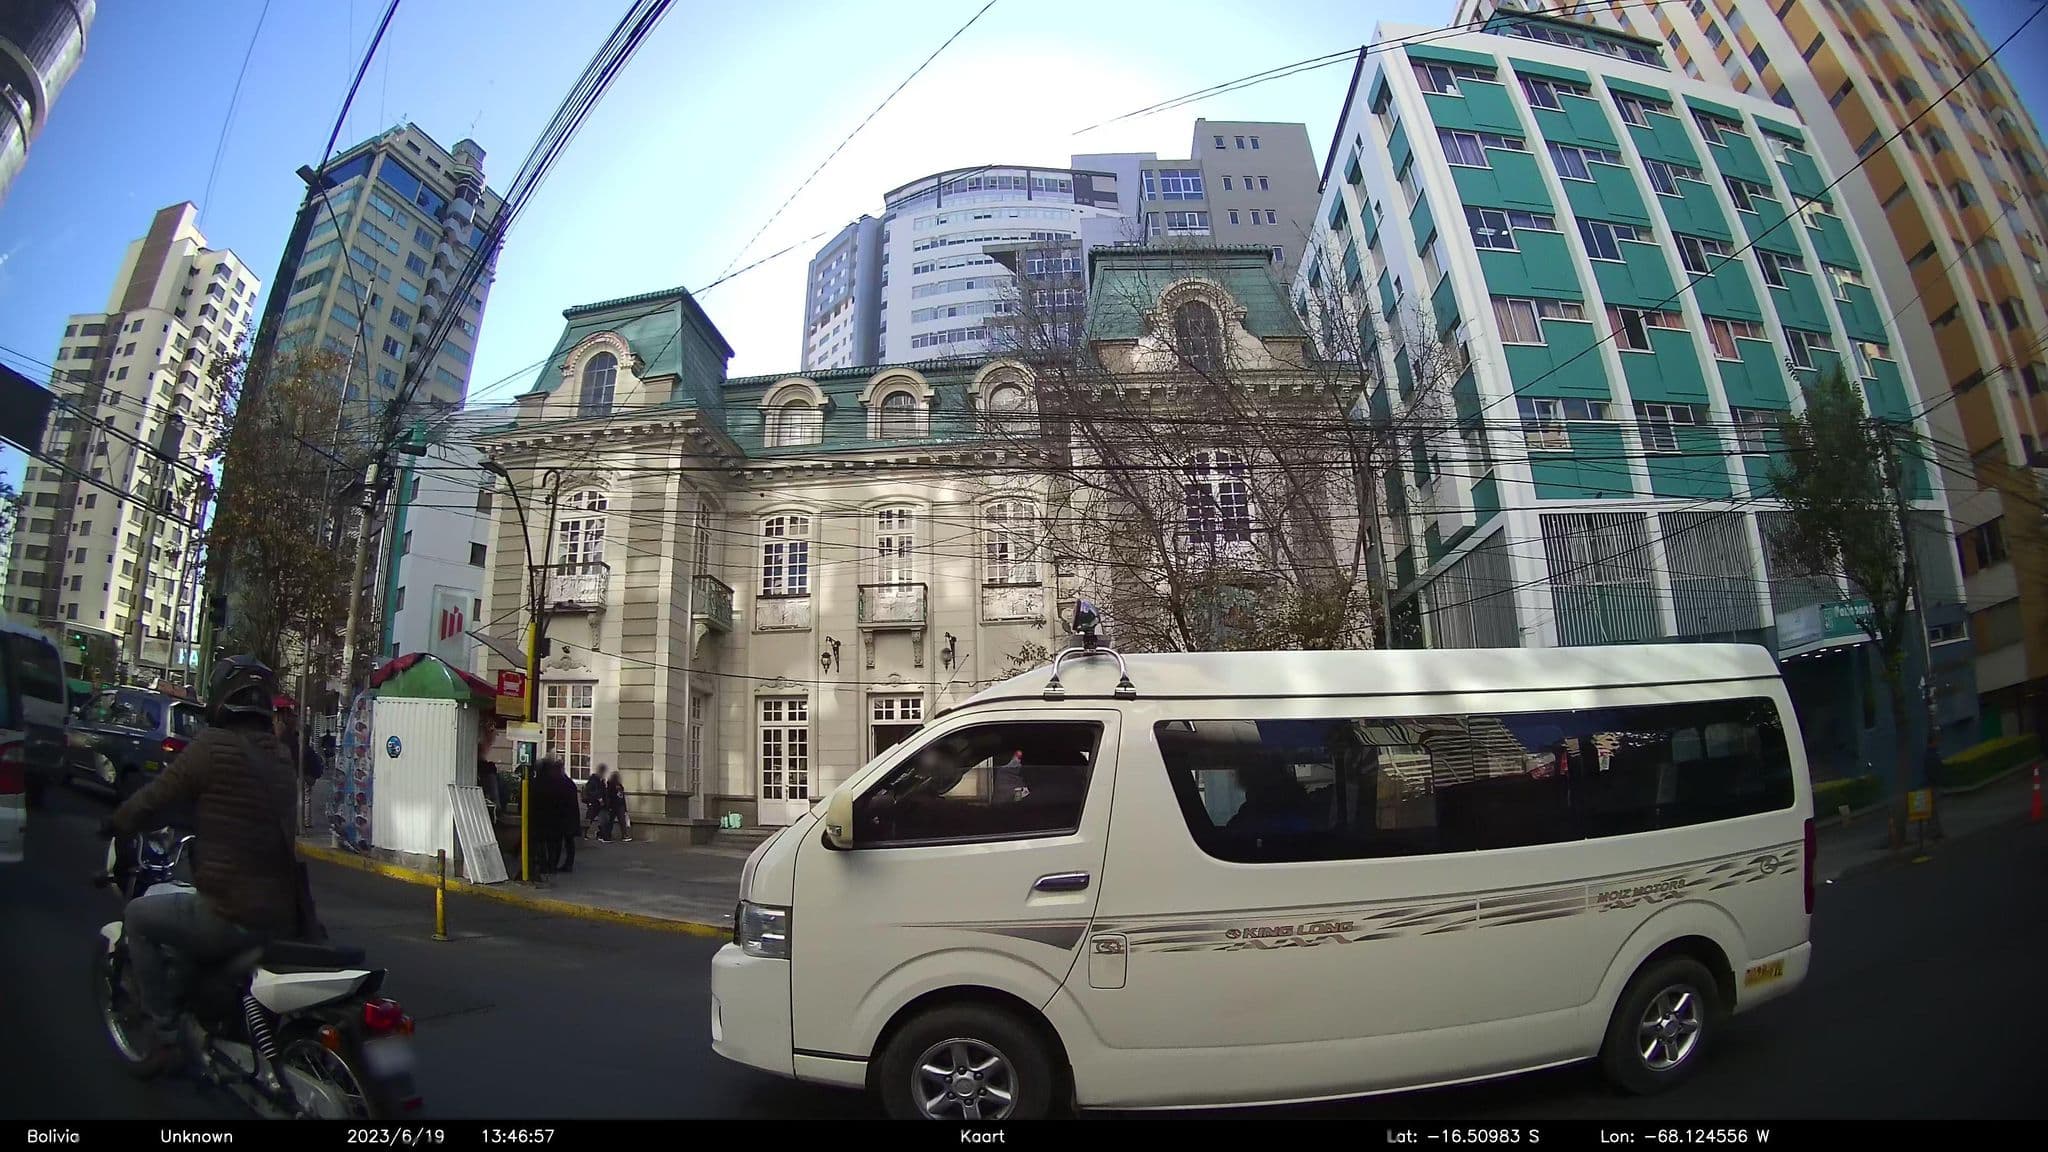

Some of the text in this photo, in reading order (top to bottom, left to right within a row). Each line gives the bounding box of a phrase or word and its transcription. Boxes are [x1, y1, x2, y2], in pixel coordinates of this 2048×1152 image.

[1632, 879, 1686, 897] MOTORS
[1242, 921, 1354, 939] KING LONG
